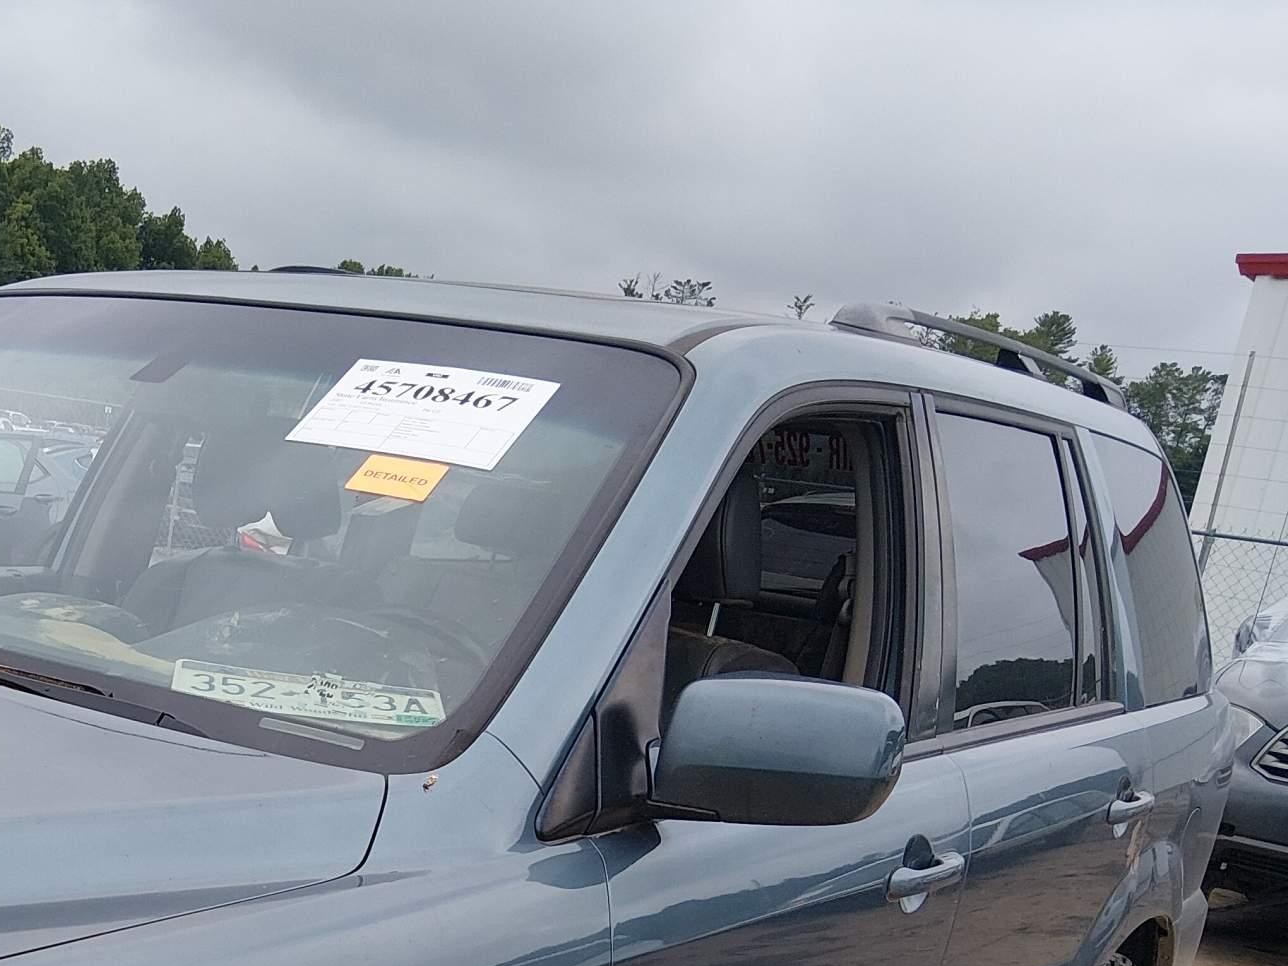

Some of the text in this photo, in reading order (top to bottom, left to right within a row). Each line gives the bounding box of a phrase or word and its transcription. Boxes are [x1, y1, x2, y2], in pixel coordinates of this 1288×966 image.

[354, 379, 518, 412] 45708467
[363, 469, 428, 487] DETAILED
[191, 673, 276, 699] 352
